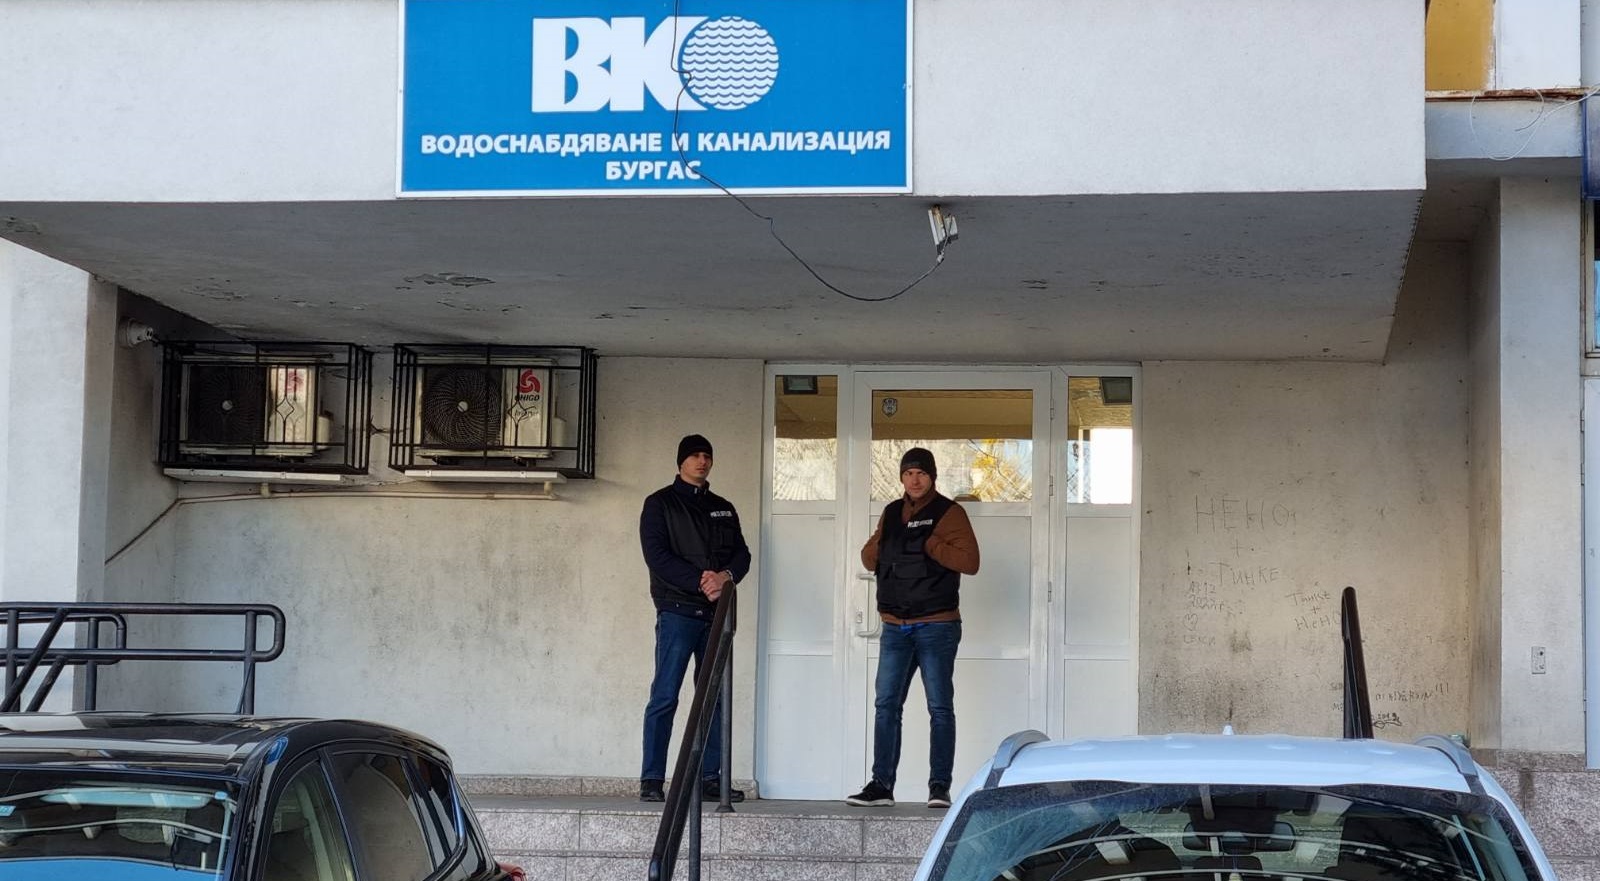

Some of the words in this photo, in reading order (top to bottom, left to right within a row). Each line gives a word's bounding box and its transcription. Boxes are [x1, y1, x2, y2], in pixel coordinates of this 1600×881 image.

[421, 132, 662, 158] ВОДОСНАБДЯВАНЕ
[672, 132, 689, 152] И
[698, 130, 891, 155] КАНАЛИЗАЦИЯ
[606, 160, 702, 181] БУРГАС
